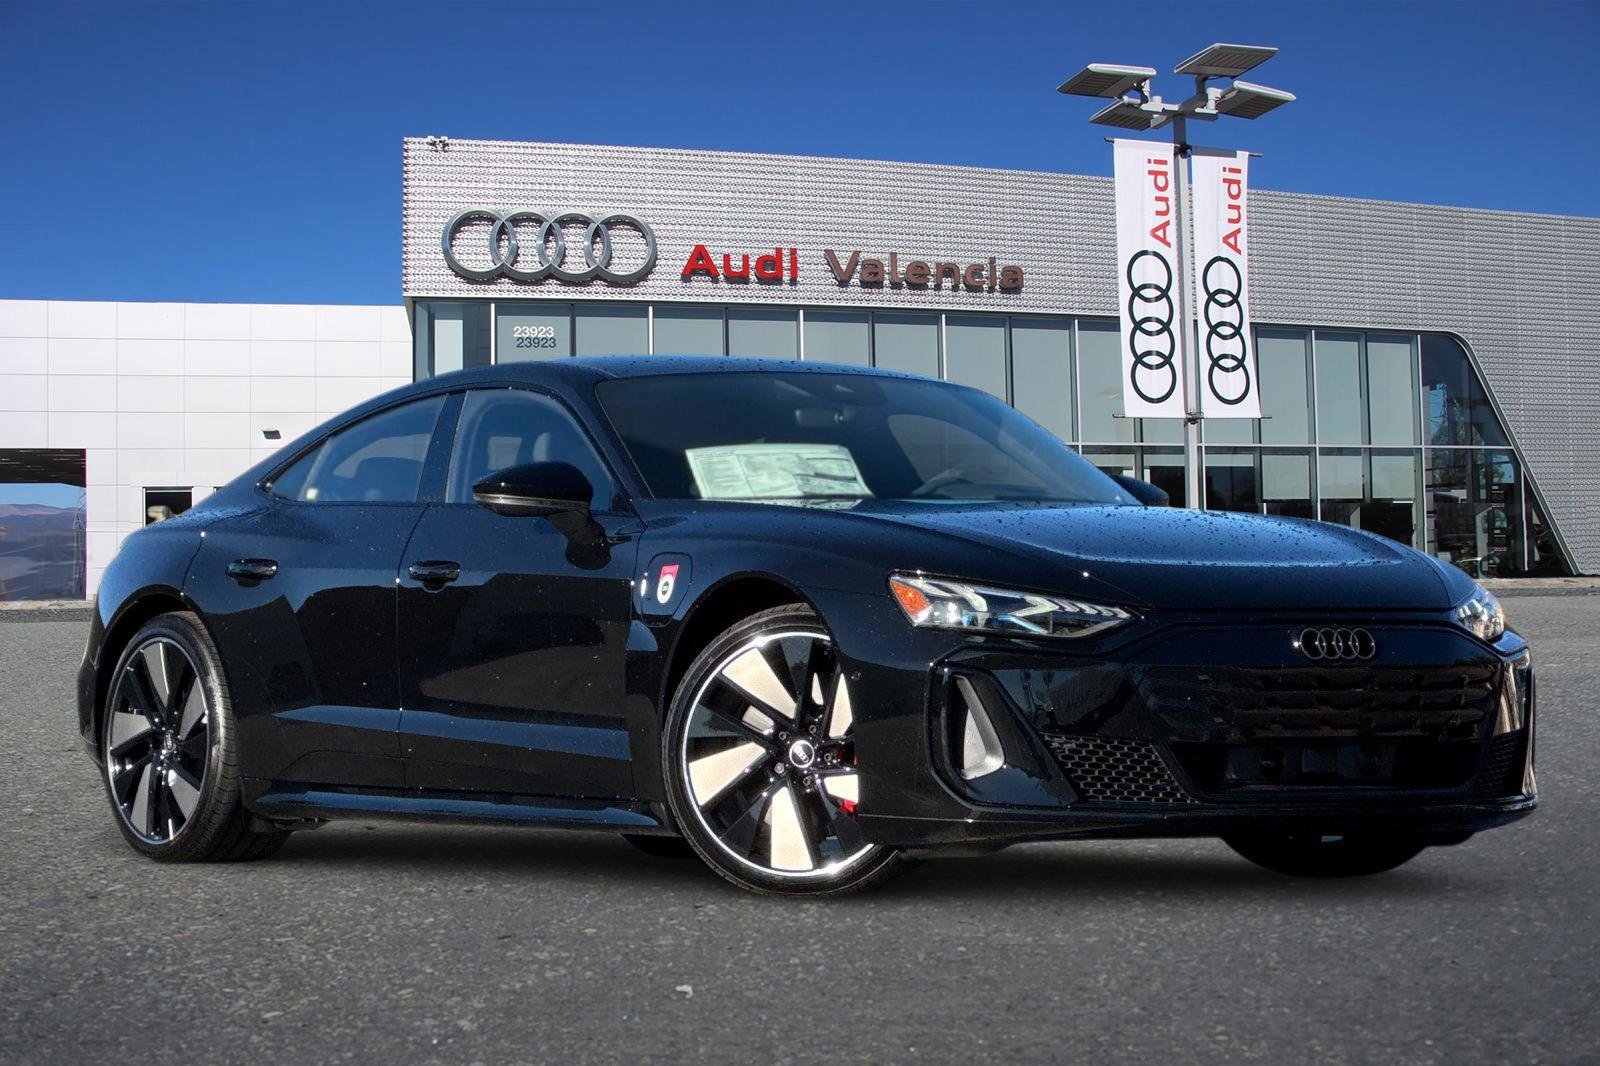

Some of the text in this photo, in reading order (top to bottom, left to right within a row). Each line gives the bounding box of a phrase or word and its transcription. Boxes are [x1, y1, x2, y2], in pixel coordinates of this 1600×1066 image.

[1147, 158, 1171, 248] Audi
[1222, 166, 1242, 255] Audi
[681, 244, 1024, 291] Audi Valencia
[513, 326, 554, 338] 23923
